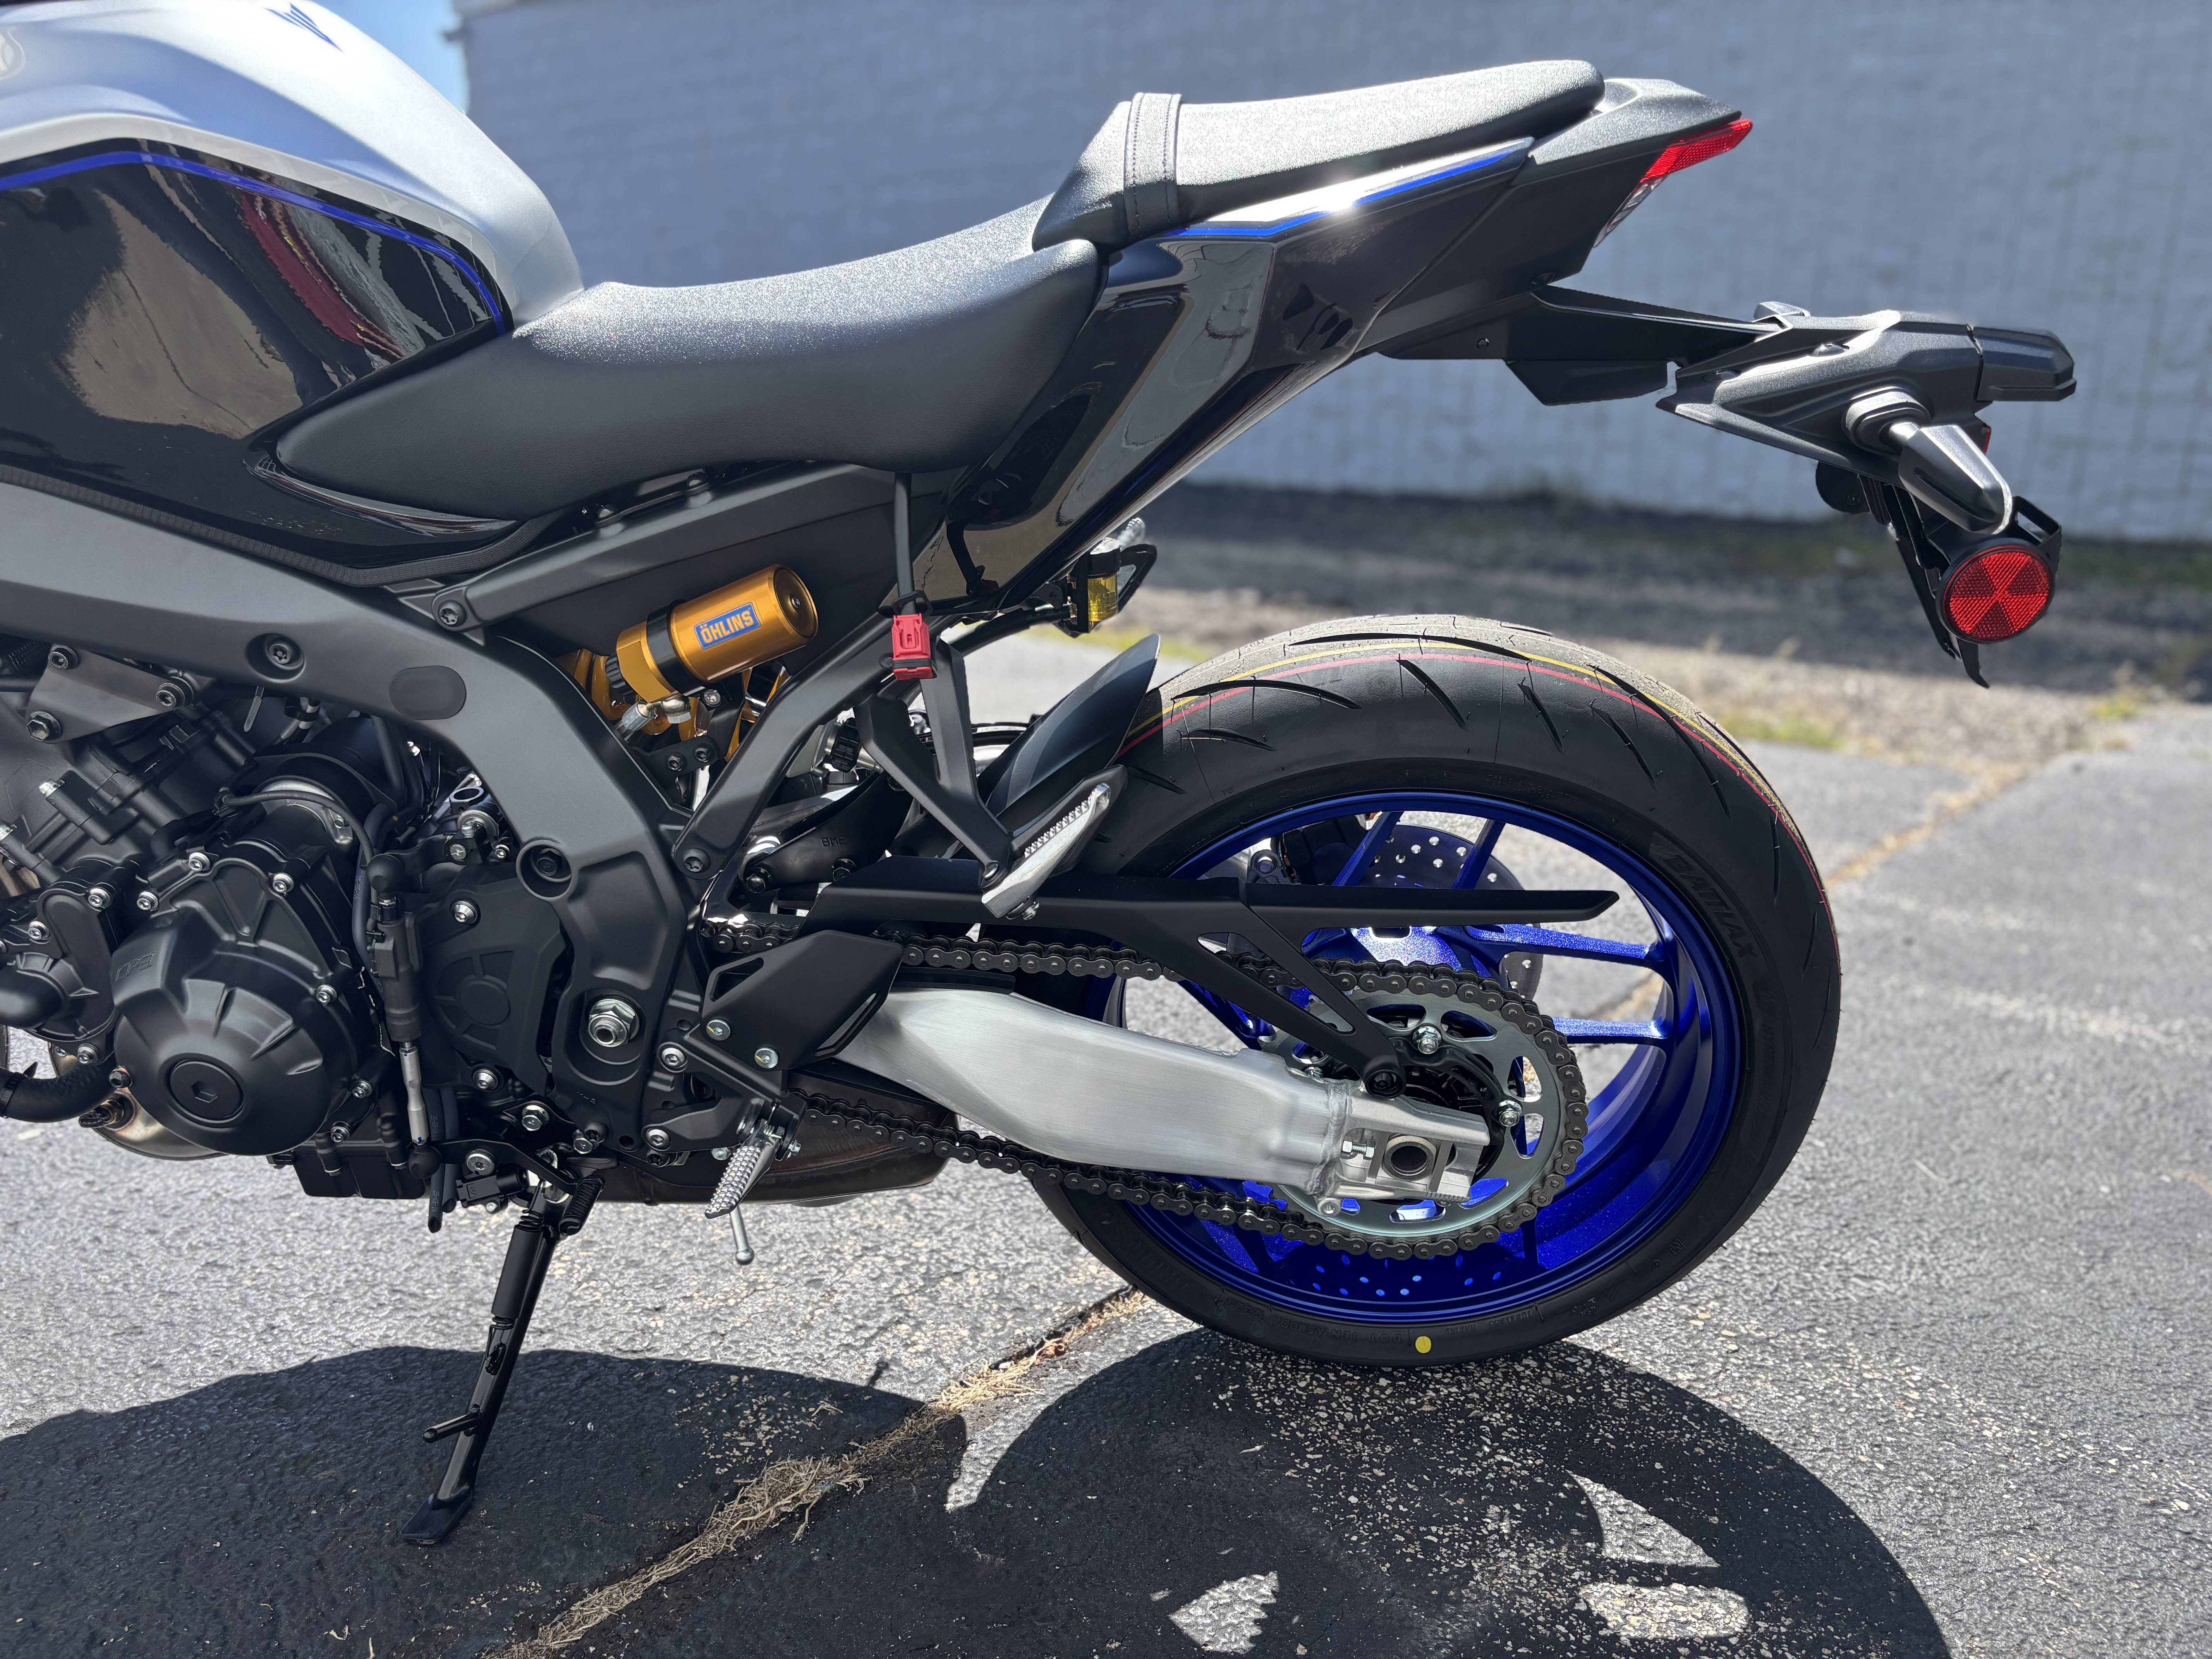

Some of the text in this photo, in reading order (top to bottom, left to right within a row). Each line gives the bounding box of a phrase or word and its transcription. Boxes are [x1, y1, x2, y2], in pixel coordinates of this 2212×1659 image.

[700, 610, 754, 644] ÖHLINS
[821, 836, 847, 848] BME
[1663, 854, 1758, 958] BATTLAX
[115, 952, 156, 982] CP3
[1329, 1329, 1357, 1341] 1EN
[1369, 1333, 1403, 1343] DOT
